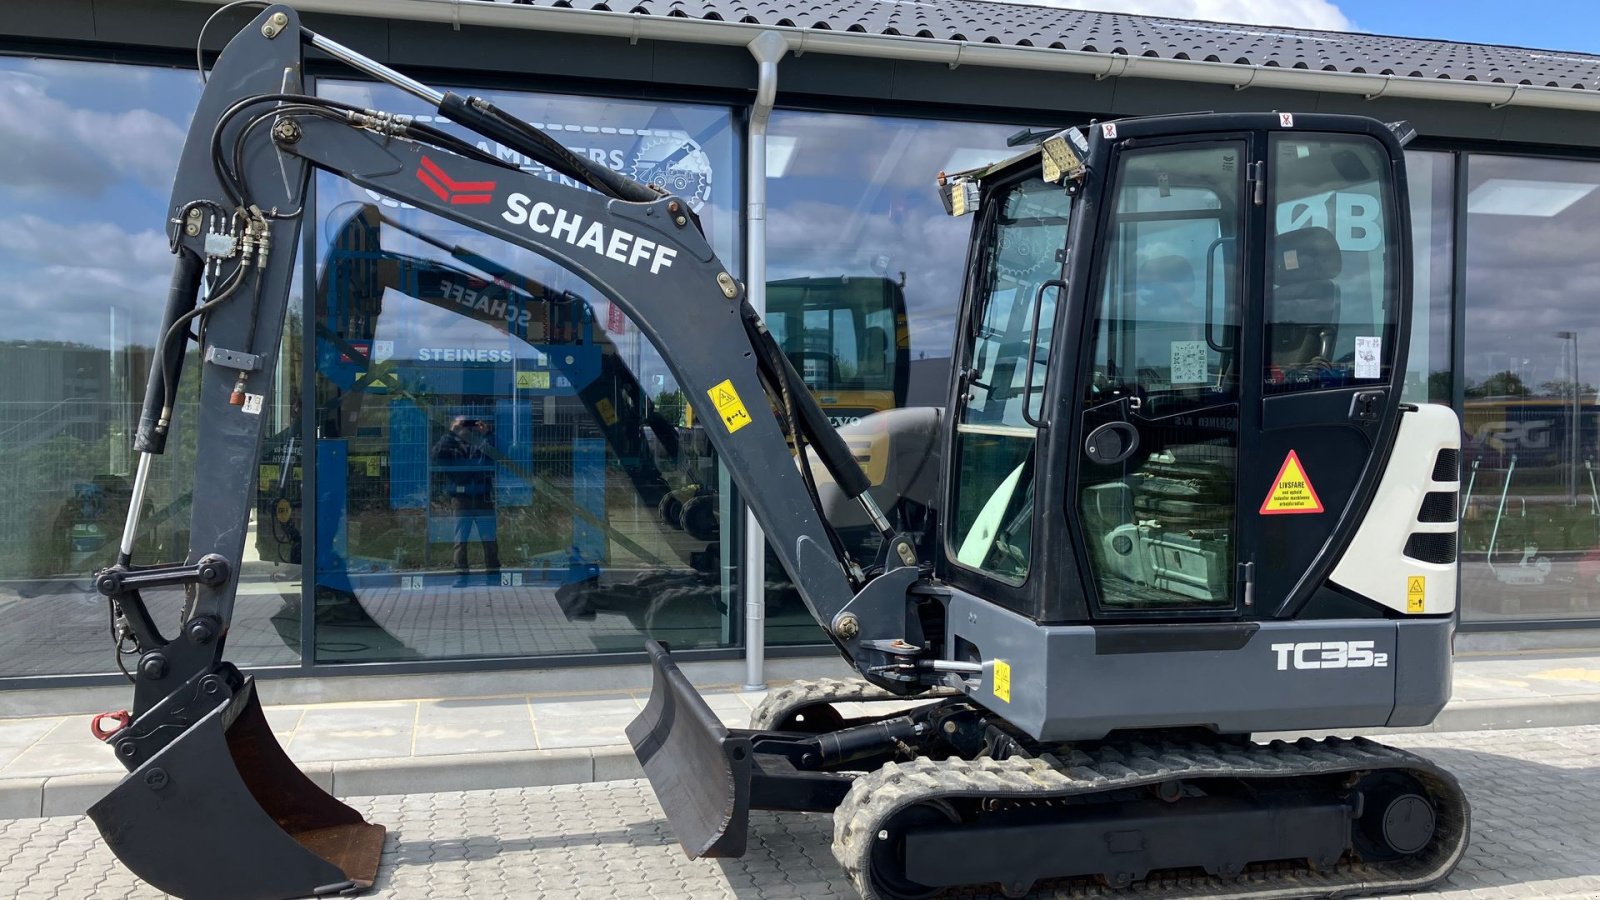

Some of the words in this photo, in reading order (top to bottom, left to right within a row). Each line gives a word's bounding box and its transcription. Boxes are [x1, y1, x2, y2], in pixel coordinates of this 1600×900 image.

[501, 192, 677, 275] SCHAEFF
[419, 347, 512, 363] STEINESS
[1279, 481, 1304, 489] LIVSFARE
